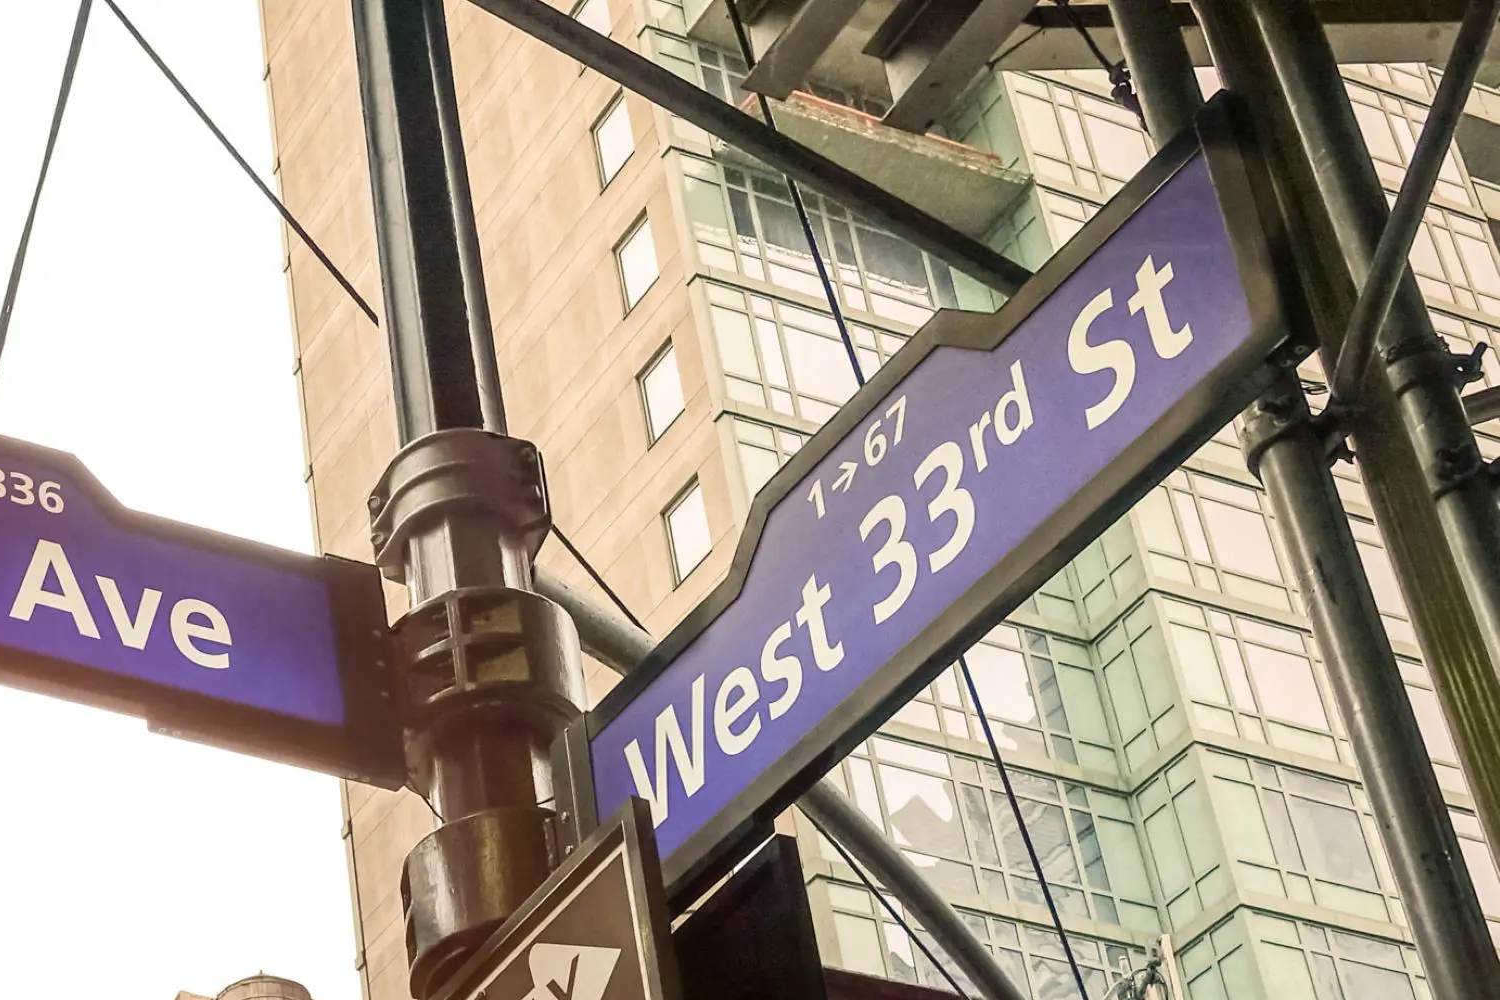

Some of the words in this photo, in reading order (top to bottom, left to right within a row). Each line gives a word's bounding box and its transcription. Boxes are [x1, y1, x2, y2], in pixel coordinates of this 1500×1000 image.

[863, 394, 907, 467] 67
[8, 539, 233, 669] Ave
[623, 572, 845, 830] West
[858, 358, 1035, 626] 33rd
[1067, 254, 1194, 431] St
